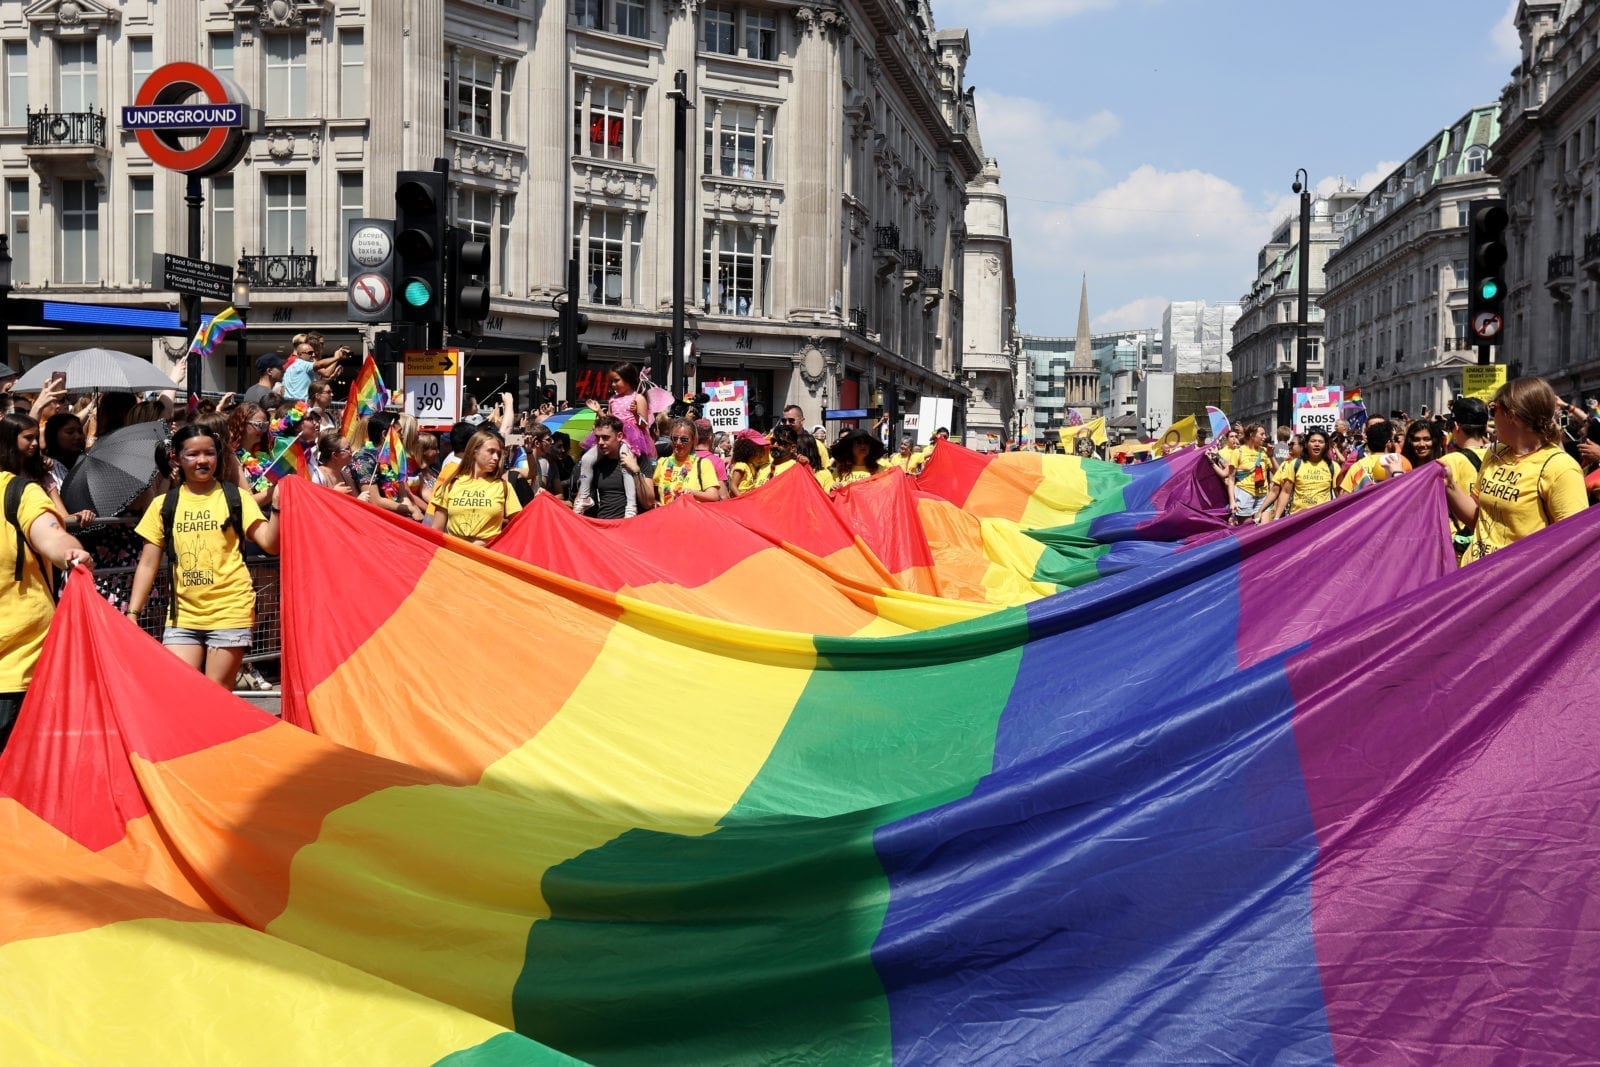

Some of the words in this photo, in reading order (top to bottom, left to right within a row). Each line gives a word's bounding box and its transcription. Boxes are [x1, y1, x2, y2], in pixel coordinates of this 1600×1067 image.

[126, 109, 237, 124] UNDERGROUND
[172, 257, 186, 266] Bond
[186, 260, 204, 269] Street
[171, 274, 196, 286] Piccadilly
[196, 280, 213, 289] Circus
[423, 382, 439, 396] 10
[416, 396, 443, 411] 390
[709, 407, 742, 417] CROSS
[712, 417, 739, 426] HERE
[1300, 414, 1336, 424] CROSS
[1491, 467, 1522, 486] FLAG
[461, 489, 486, 498] FLAG
[1479, 478, 1521, 503] BEARER
[452, 497, 492, 507] BEARER
[184, 509, 211, 521] FLAG
[176, 520, 218, 533] BEARER
[182, 570, 204, 579] PRIDE
[205, 570, 213, 578] IN
[182, 578, 214, 588] LONDON
